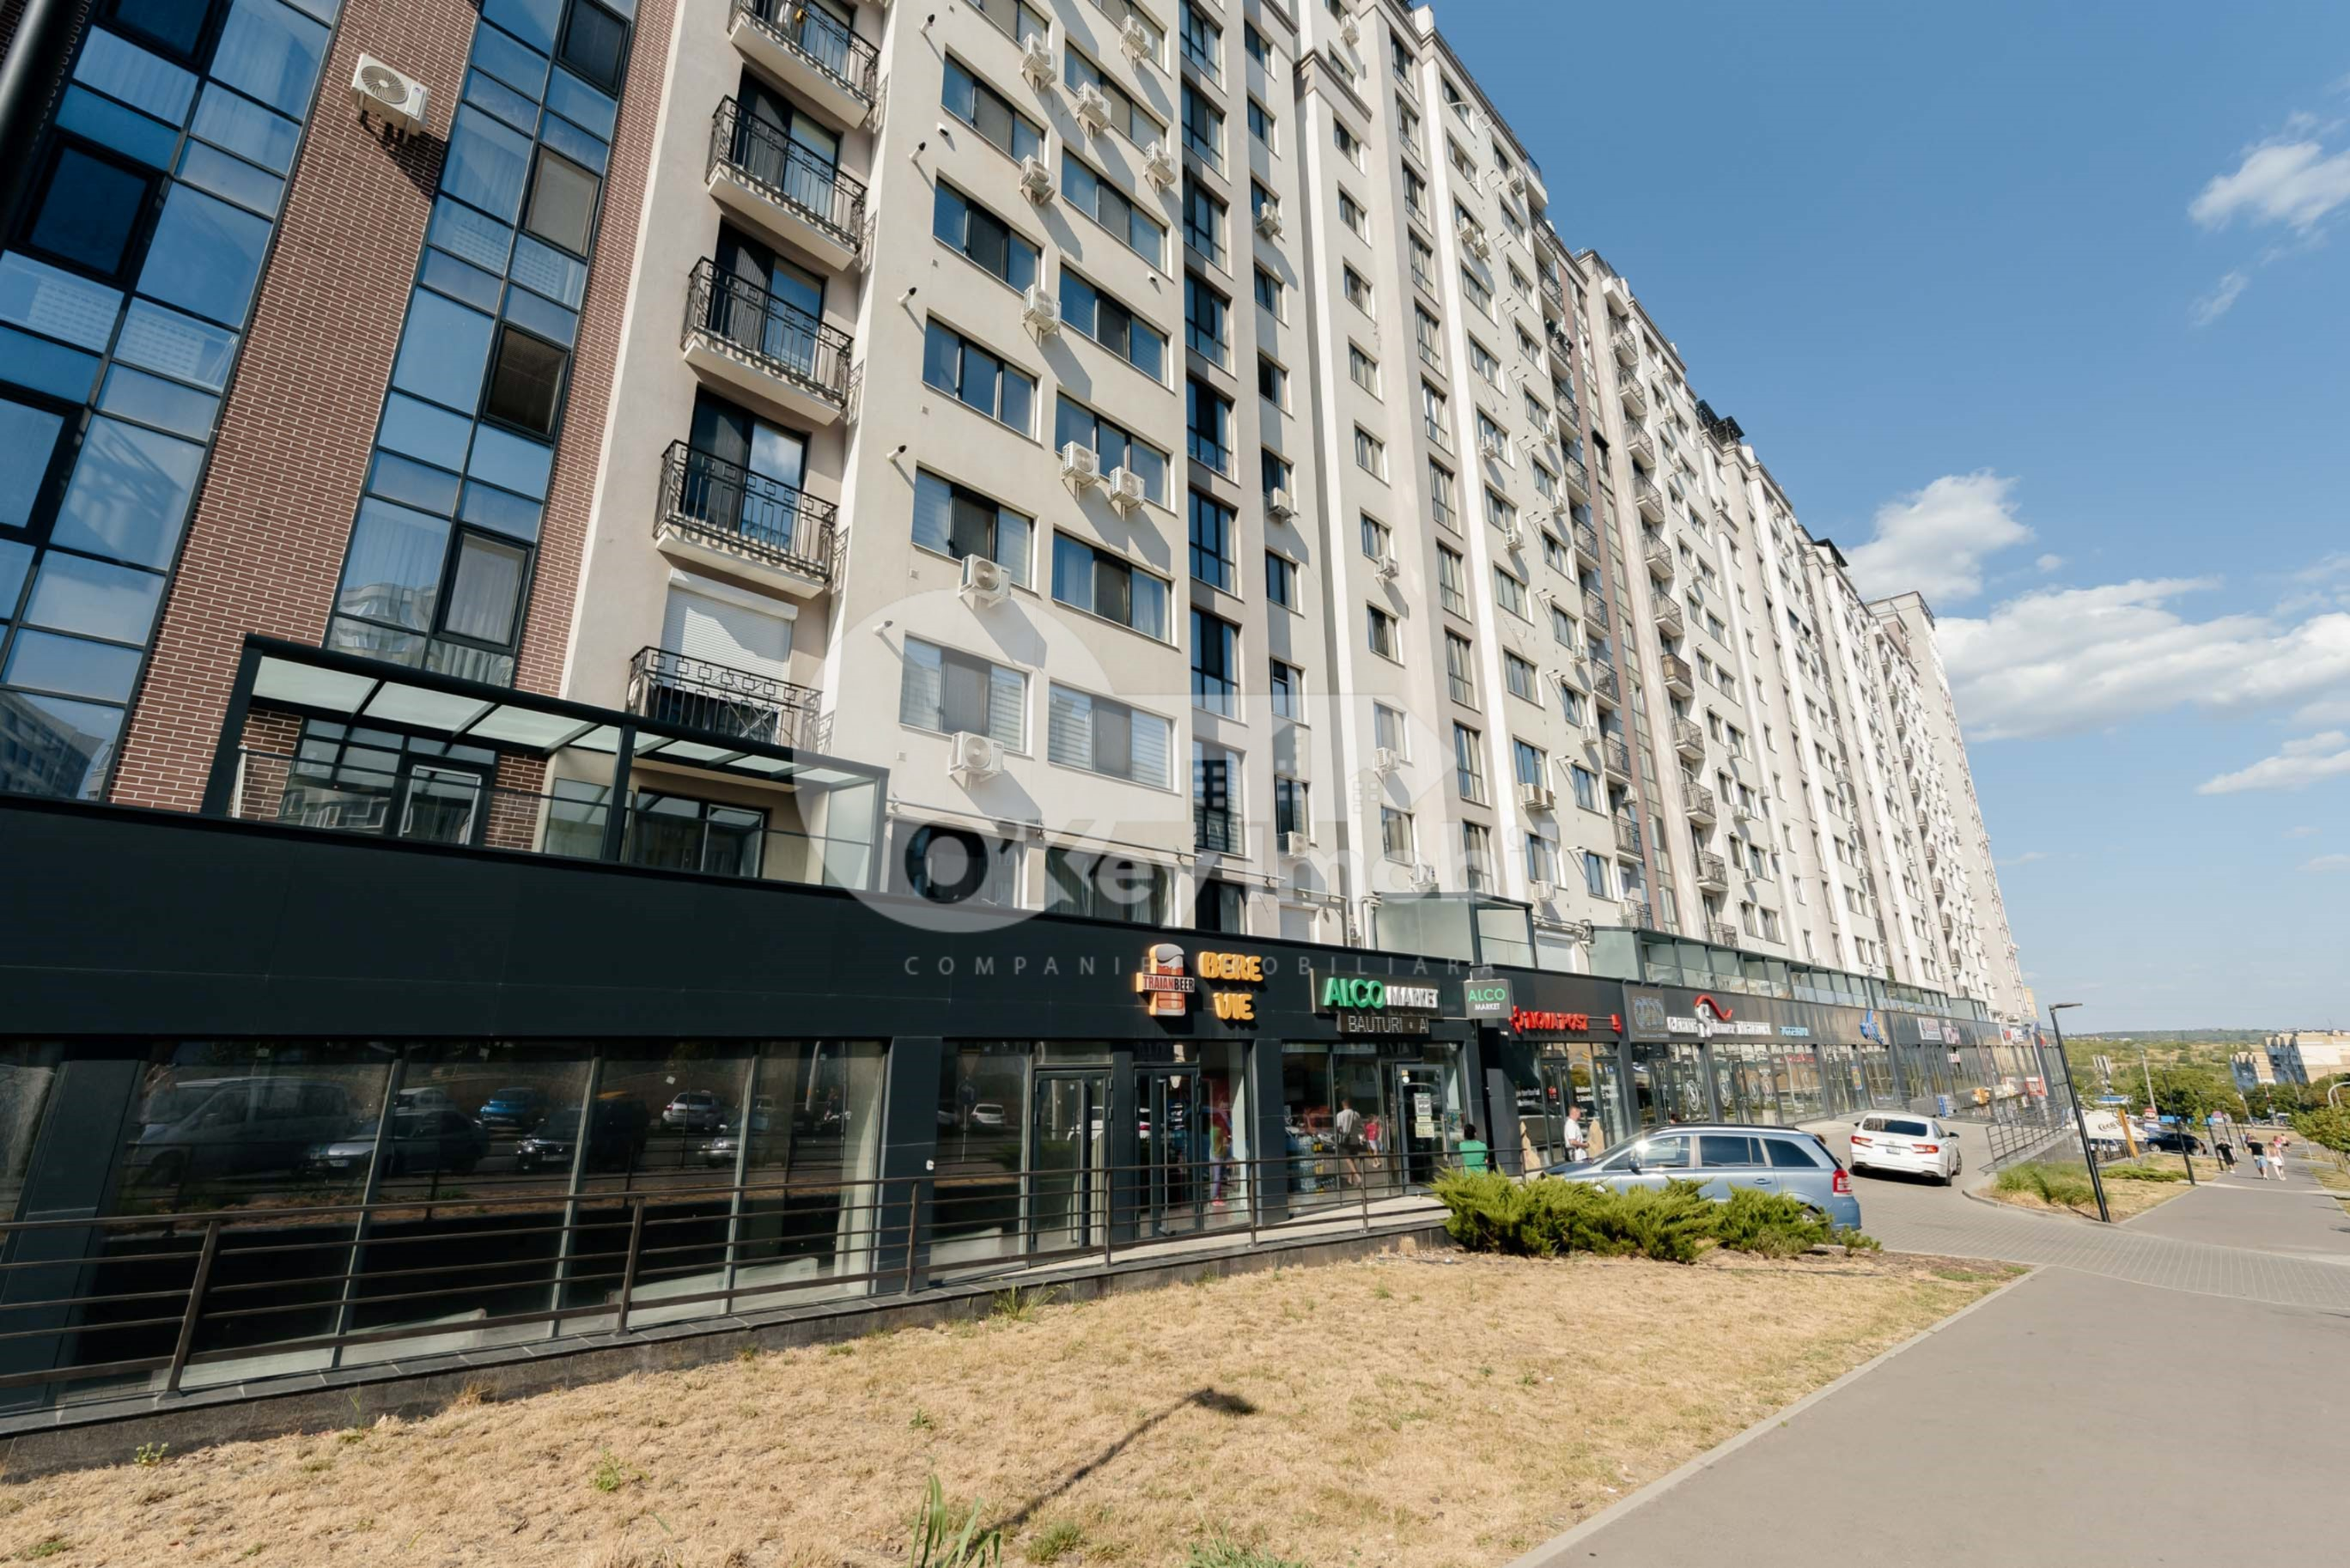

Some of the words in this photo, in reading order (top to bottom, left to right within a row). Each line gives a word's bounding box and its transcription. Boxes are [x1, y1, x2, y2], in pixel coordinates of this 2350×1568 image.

[1198, 951, 1263, 982] BERE
[1143, 975, 1195, 991] TRAIANBEER
[1323, 977, 1387, 1009] ALCO
[1385, 985, 1439, 1008] MARKET
[1468, 988, 1507, 1001] ALCO
[1213, 992, 1255, 1020] VIE
[1474, 1002, 1501, 1011] MARKET
[1348, 1015, 1403, 1033] BAUTURI
